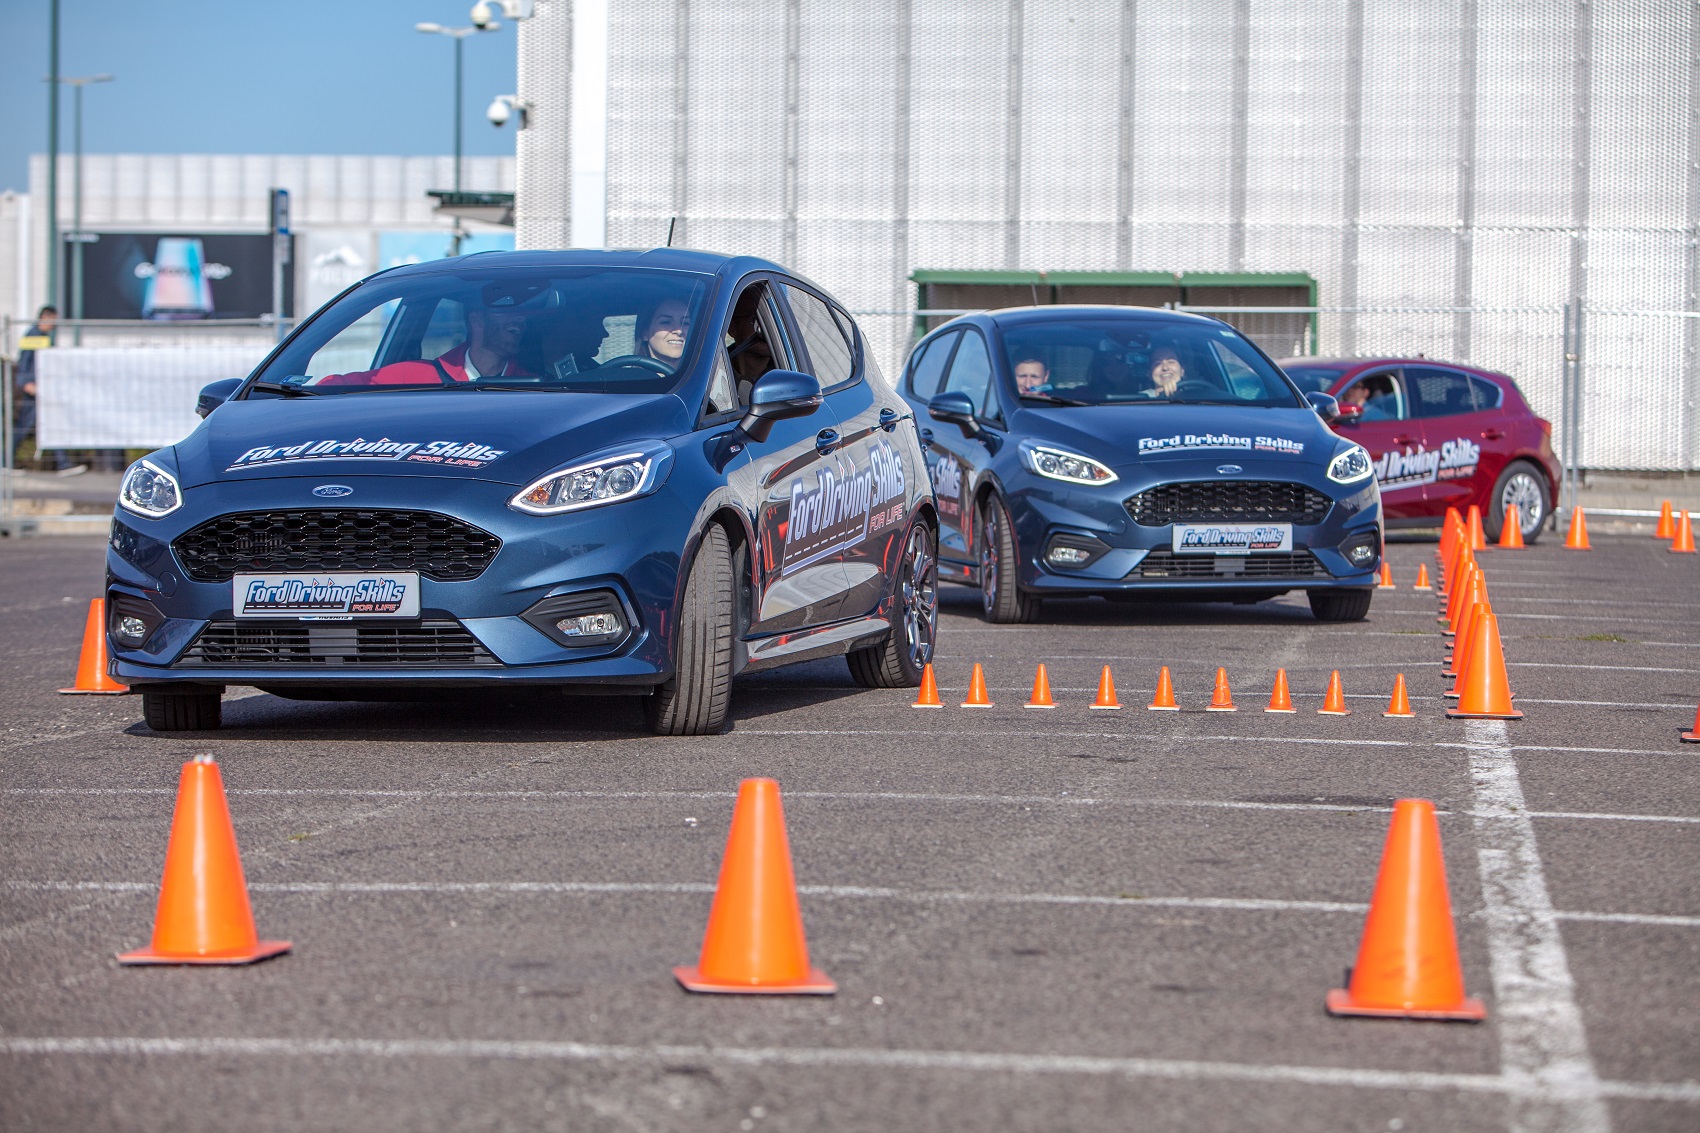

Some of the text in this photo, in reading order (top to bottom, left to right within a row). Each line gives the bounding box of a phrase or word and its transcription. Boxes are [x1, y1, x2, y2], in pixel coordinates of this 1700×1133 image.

[234, 437, 506, 464] Ford Driving Skills
[1138, 433, 1304, 451] Ford Driving Skills
[407, 454, 482, 468] FOR LIFE
[1372, 437, 1480, 480] rd Driving Skills
[935, 452, 961, 498] Skills
[787, 438, 905, 544] Ford Driving Skills
[869, 504, 904, 533] FOR LIFE
[1182, 527, 1284, 545] Ford Driving Skills
[246, 577, 406, 606] Ford Driving Skills
